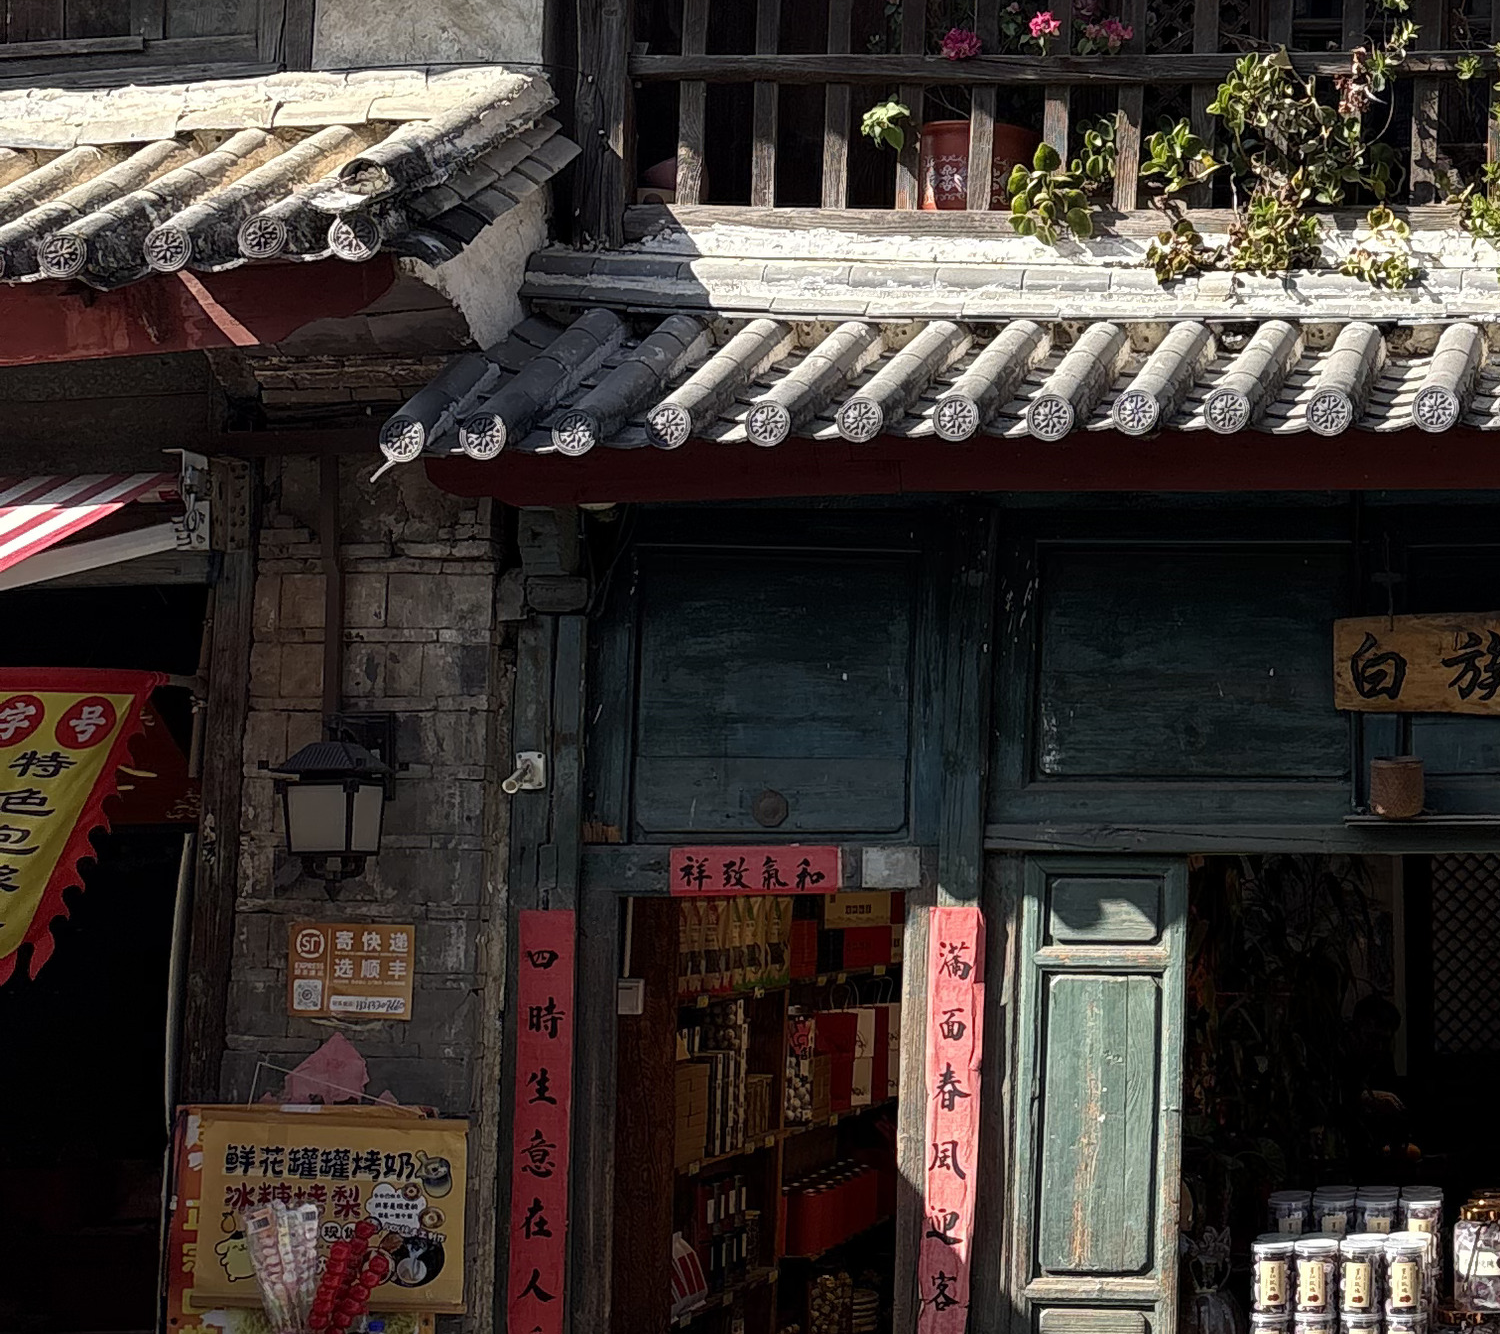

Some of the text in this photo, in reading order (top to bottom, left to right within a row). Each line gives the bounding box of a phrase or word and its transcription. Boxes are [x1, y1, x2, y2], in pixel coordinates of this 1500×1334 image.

[335, 930, 409, 952] 寄快递
[333, 958, 407, 980] 选顺丰
[225, 1144, 417, 1182] 鲜花罐罐烤奶
